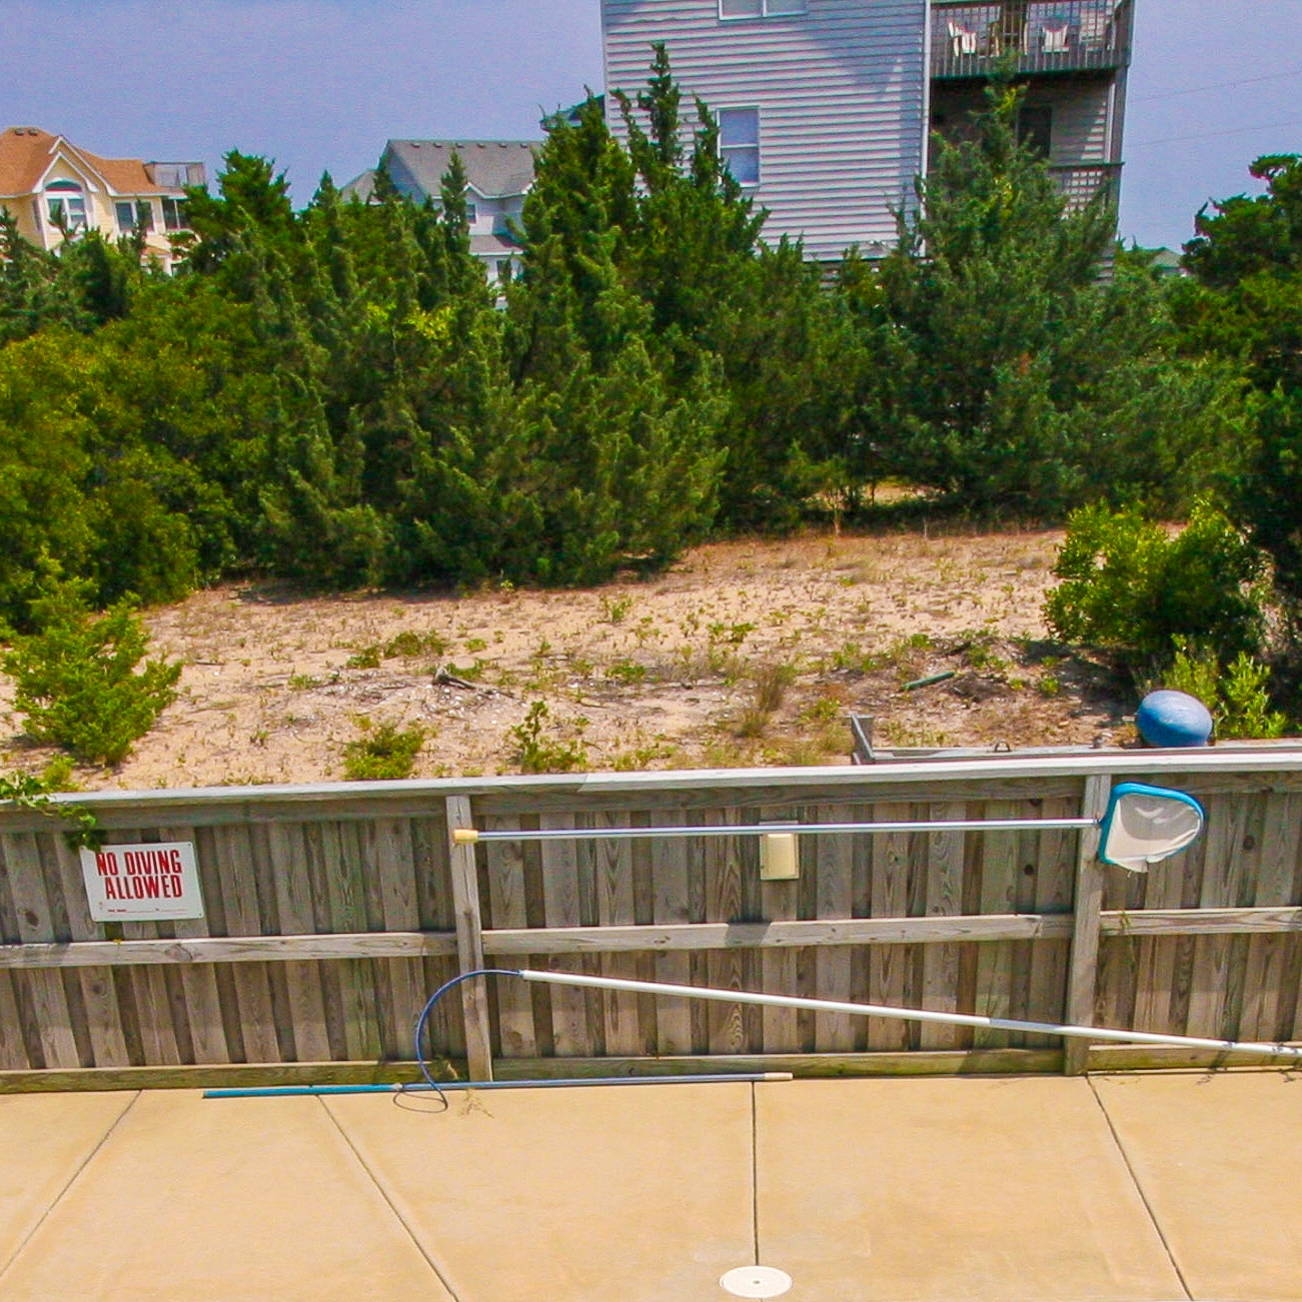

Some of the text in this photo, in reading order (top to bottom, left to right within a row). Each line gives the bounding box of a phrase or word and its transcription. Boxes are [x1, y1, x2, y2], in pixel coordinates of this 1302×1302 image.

[95, 849, 183, 876] NO DIVING
[104, 875, 183, 900] ALLOWED
